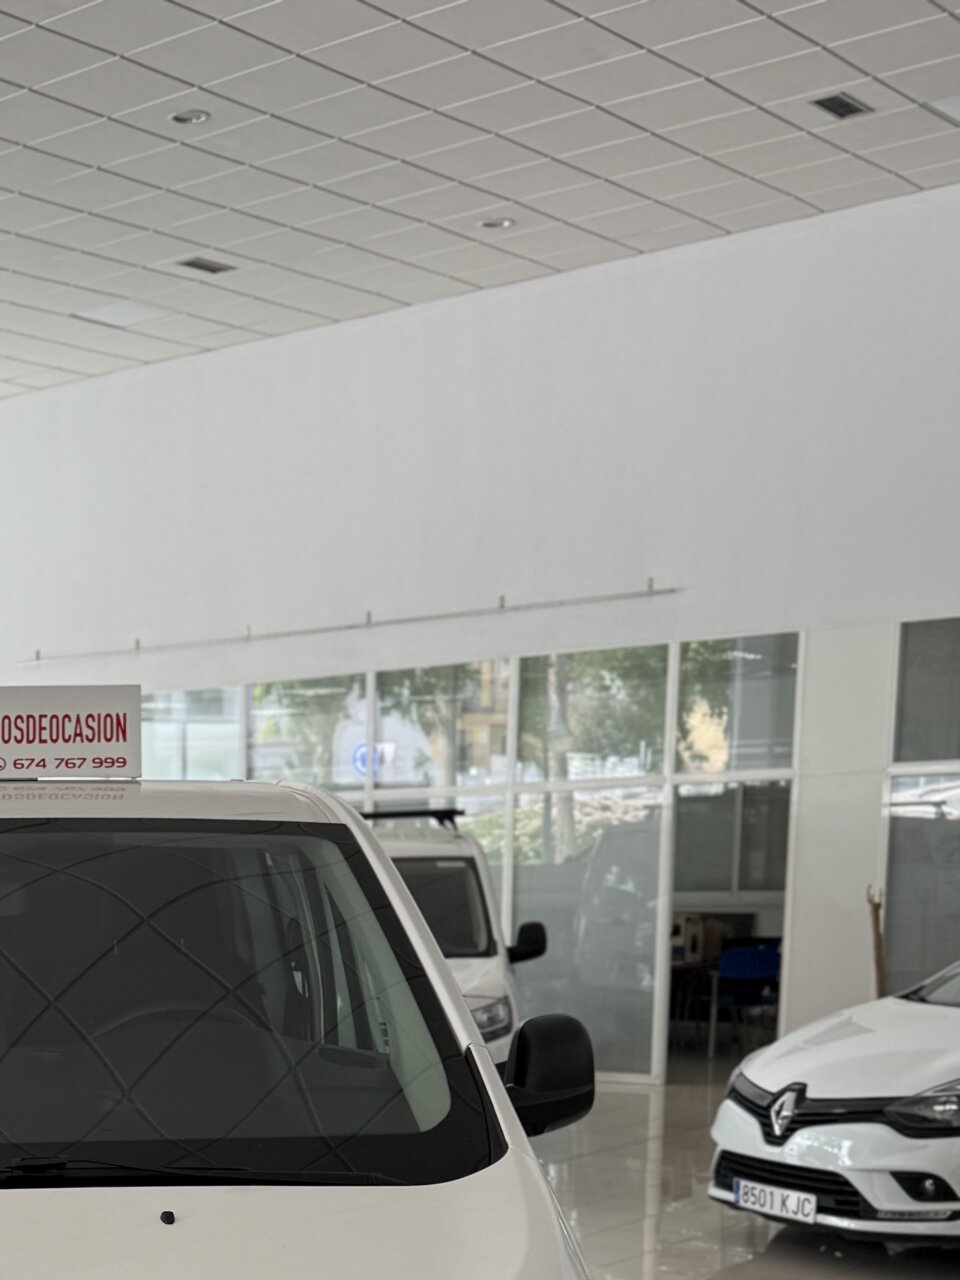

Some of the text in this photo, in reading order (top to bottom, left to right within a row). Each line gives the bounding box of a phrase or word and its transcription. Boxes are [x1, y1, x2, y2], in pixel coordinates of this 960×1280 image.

[13, 757, 127, 770] 674 767 999
[742, 1184, 812, 1218] 8501 KJC
